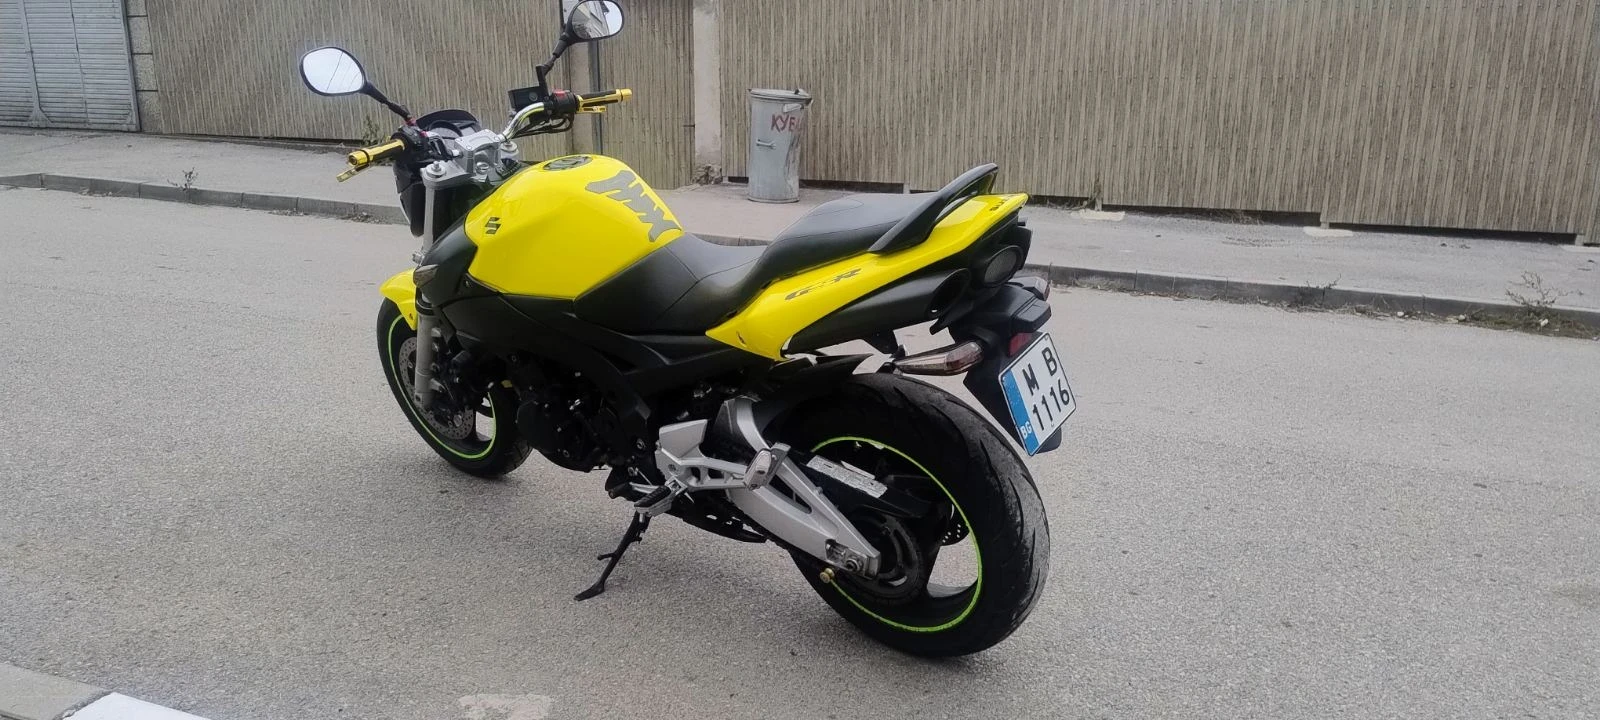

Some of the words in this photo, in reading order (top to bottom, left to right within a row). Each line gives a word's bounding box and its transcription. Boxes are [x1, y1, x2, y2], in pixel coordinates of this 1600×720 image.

[1022, 363, 1039, 396] M
[1042, 347, 1057, 376] B
[1032, 379, 1070, 431] 1116
[1021, 421, 1032, 439] BG
